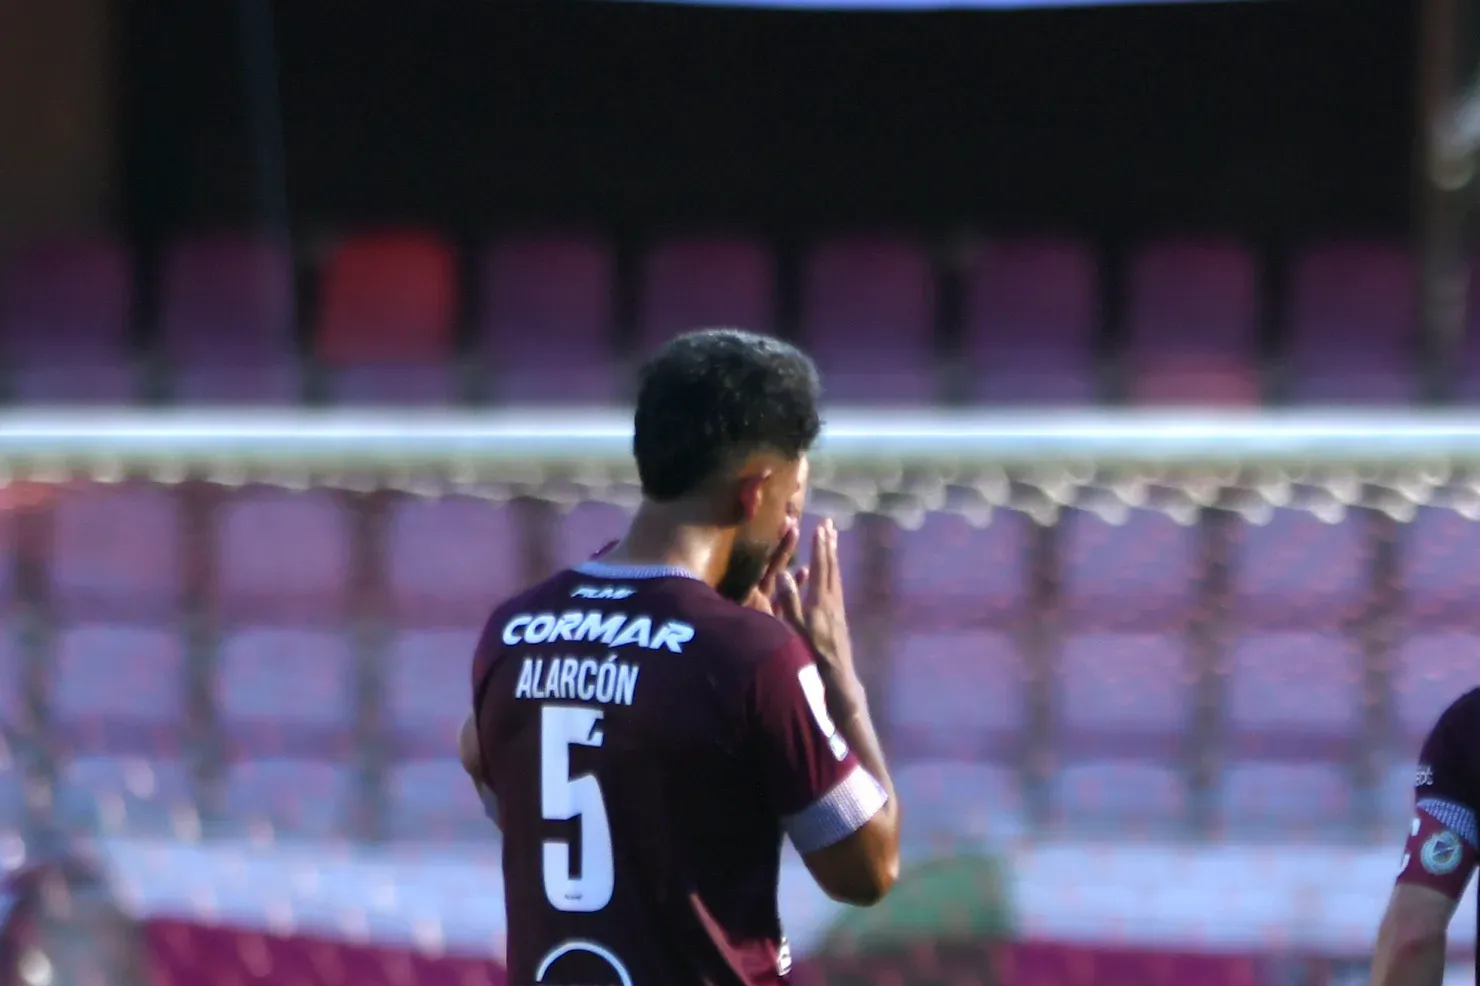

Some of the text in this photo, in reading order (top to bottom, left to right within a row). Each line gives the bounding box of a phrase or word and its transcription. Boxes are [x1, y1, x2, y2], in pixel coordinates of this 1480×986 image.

[502, 611, 695, 653] CORMAR
[515, 654, 639, 706] ALARCÓN
[541, 706, 614, 912] 5
